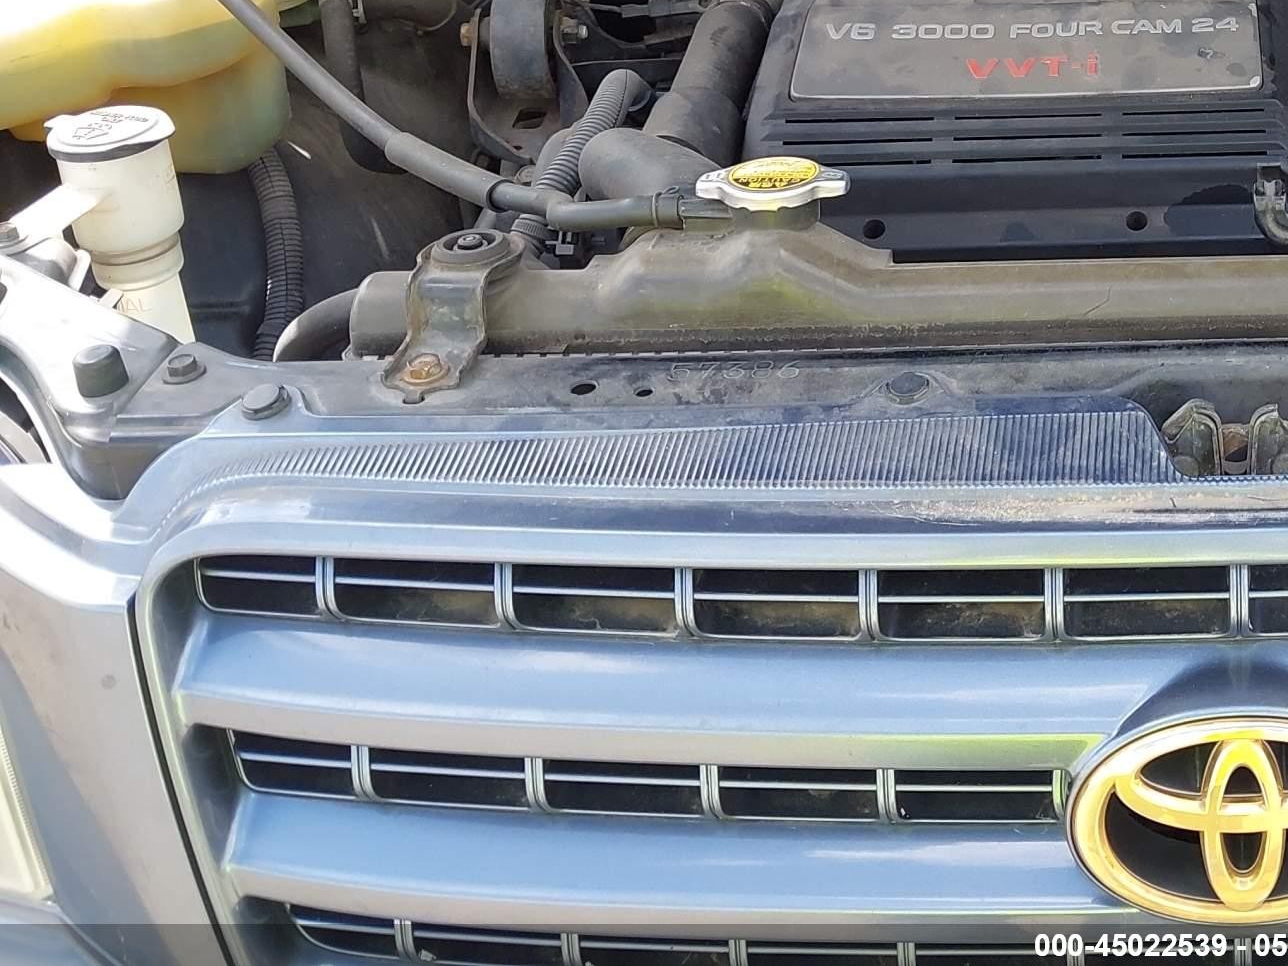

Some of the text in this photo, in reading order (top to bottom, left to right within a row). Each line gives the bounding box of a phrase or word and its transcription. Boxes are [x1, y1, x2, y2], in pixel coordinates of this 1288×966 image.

[825, 17, 1240, 41] V6 3000 FOUR CAM 24
[965, 52, 1099, 80] VVT-i
[667, 359, 801, 381] 57386
